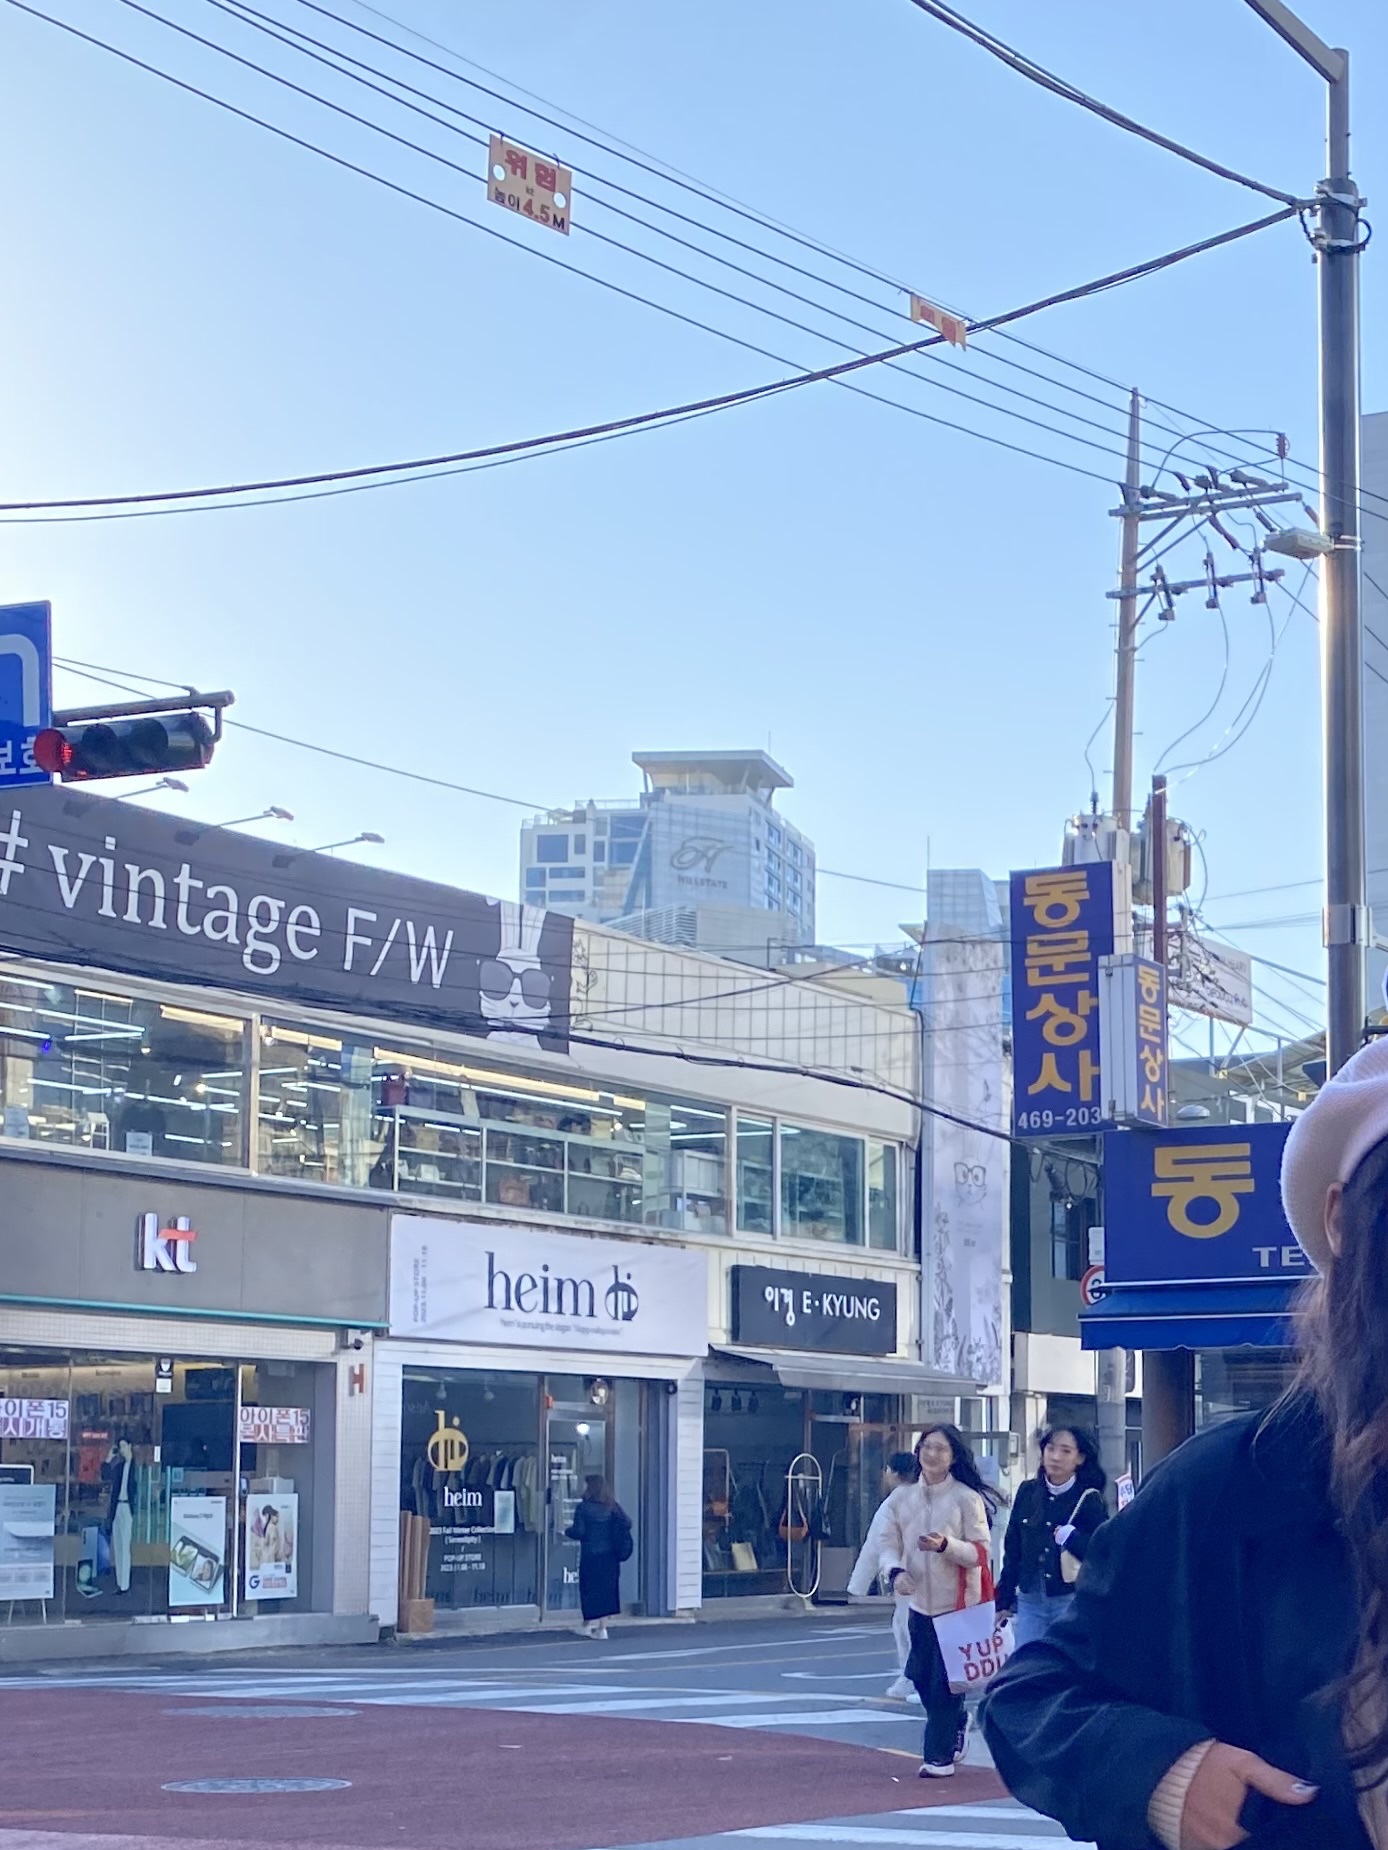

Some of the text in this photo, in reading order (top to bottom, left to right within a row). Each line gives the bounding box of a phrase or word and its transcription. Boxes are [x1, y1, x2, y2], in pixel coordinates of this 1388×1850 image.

[48, 836, 322, 975] vintage
[343, 908, 455, 990] F/W
[1024, 870, 1100, 1102] 동문상사
[1137, 964, 1164, 1122] 동문상사
[143, 1212, 199, 1273] kt
[1252, 1246, 1308, 1267] TE
[484, 1251, 598, 1318] heim
[764, 1285, 796, 1327] 이경
[0, 1400, 67, 1419] 이폰15
[443, 1486, 483, 1507] heim
[958, 1635, 1004, 1662] YUP
